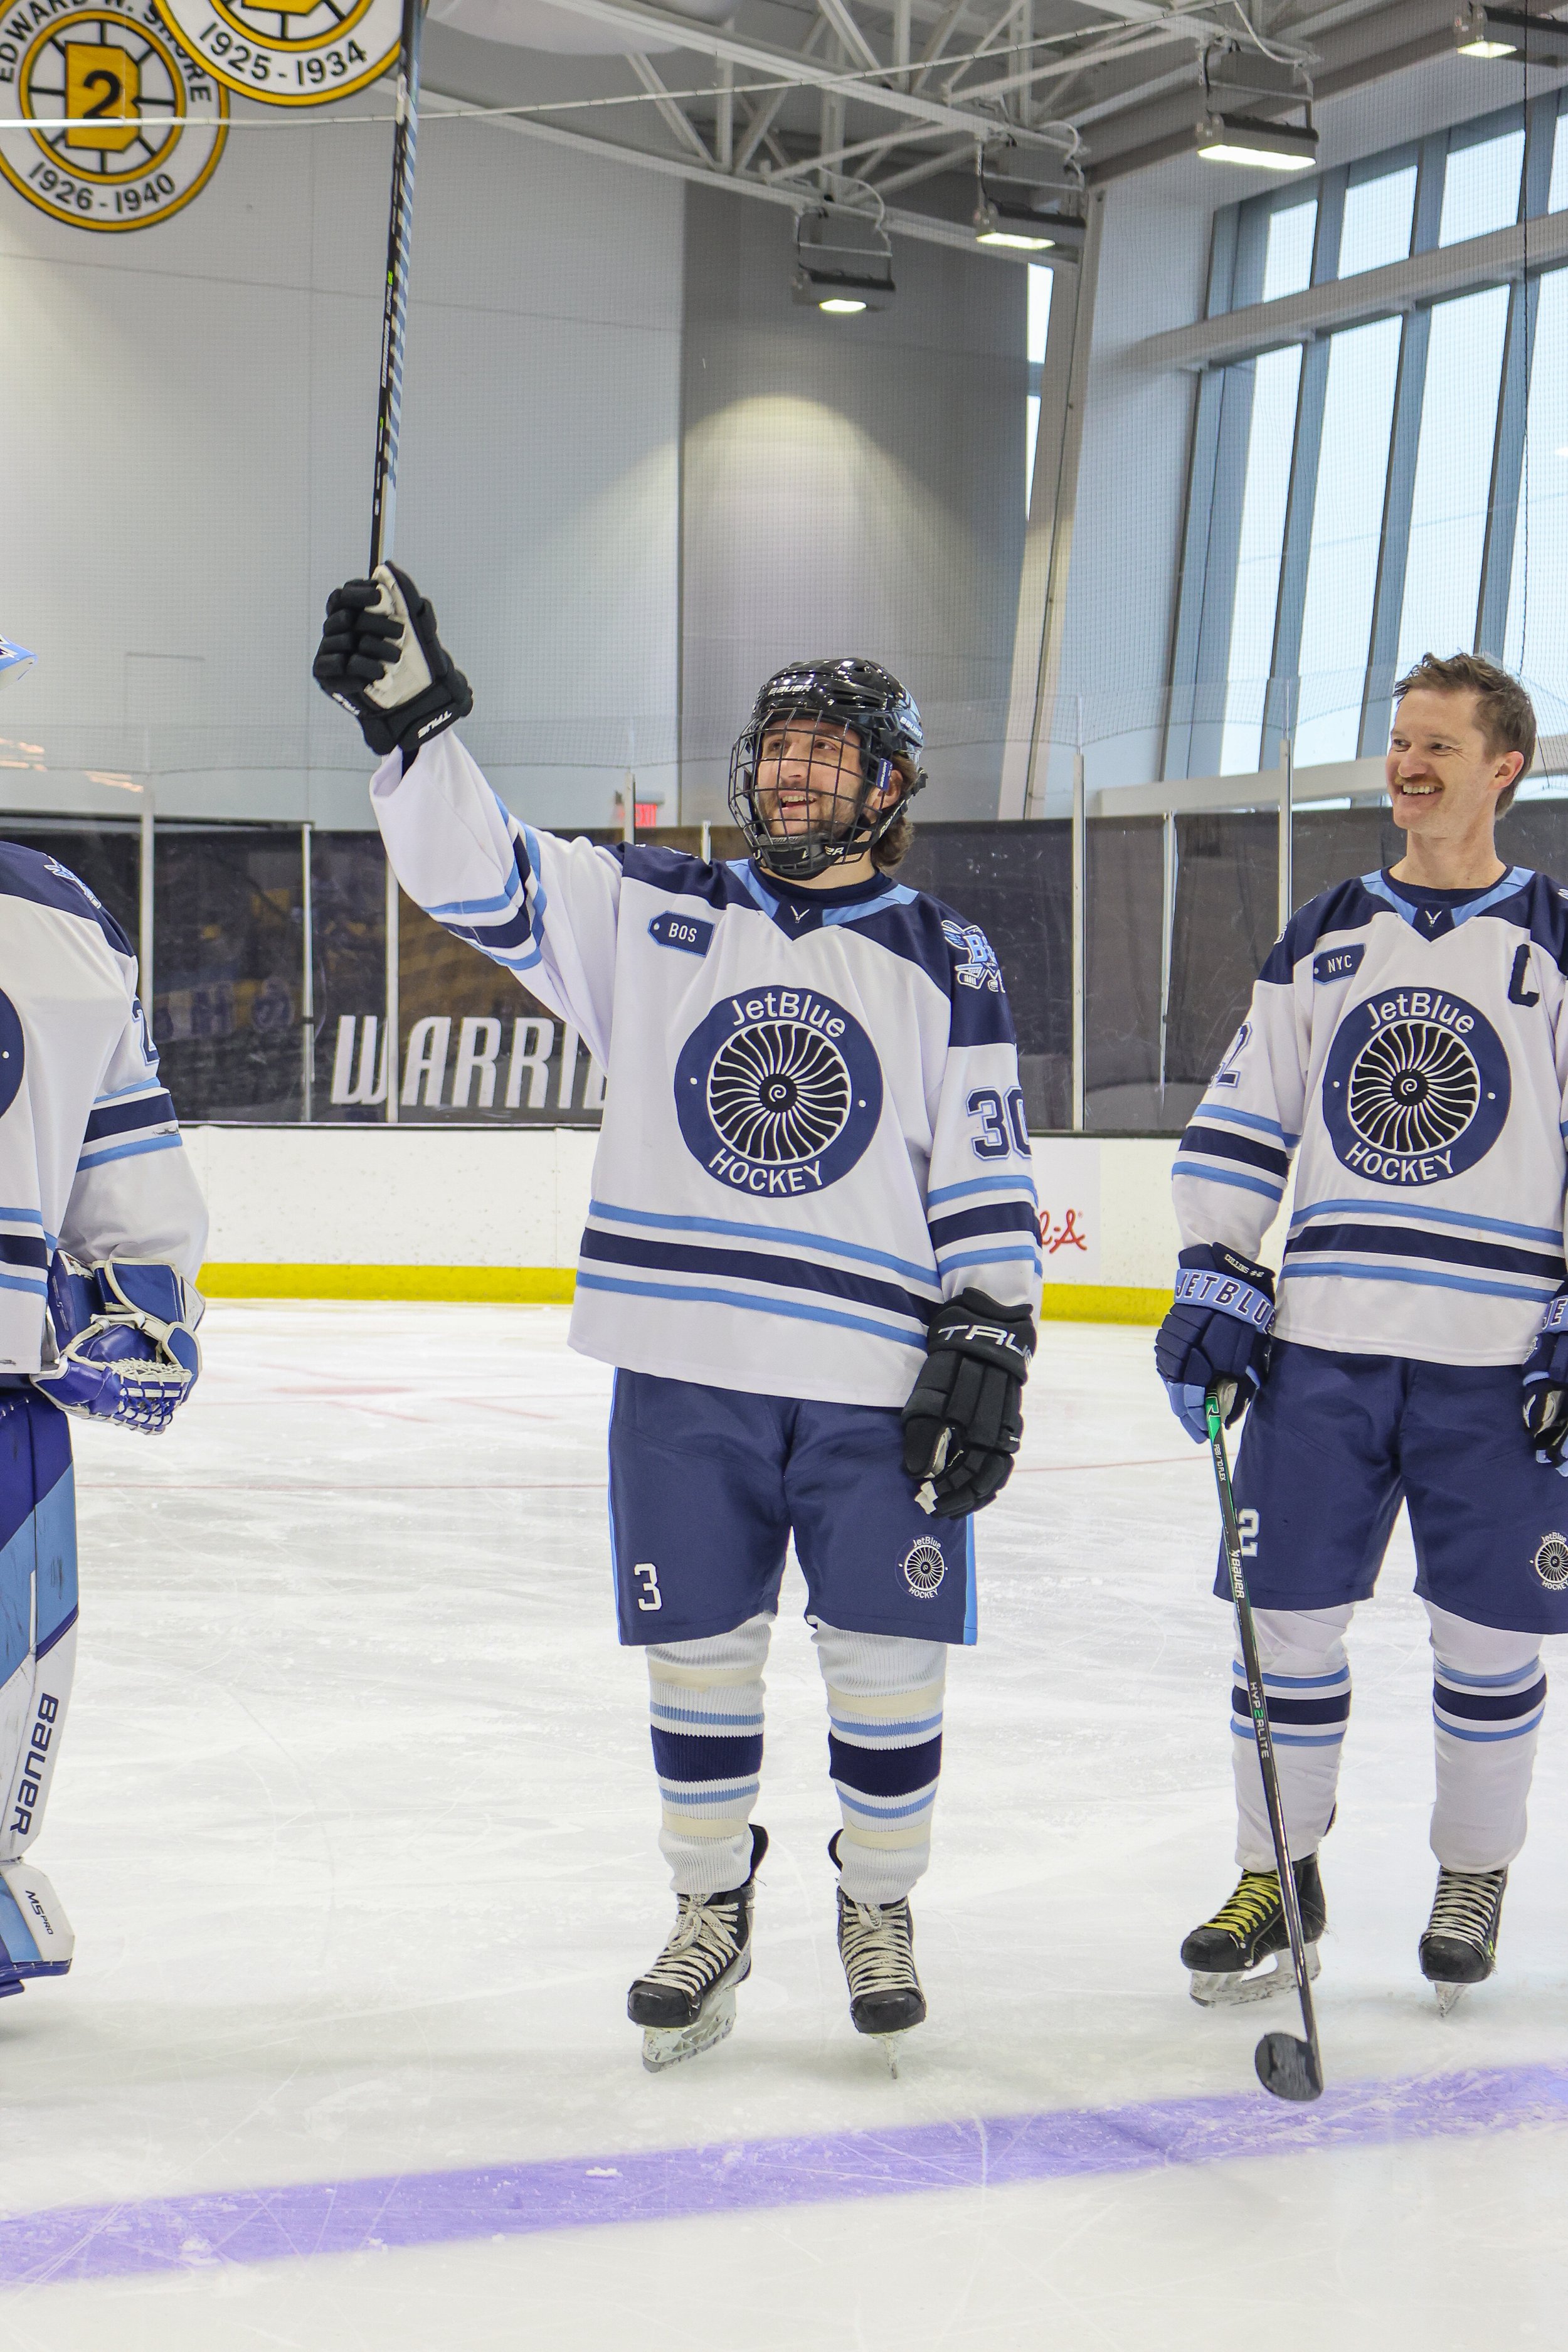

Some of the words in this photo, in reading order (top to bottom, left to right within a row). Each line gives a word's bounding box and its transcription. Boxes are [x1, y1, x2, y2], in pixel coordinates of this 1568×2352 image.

[0, 0, 88, 83] EDWAR
[82, 69, 123, 119] 2
[768, 684, 813, 696] BAUER
[899, 716, 923, 739] BAUER
[668, 922, 697, 943] BOS
[1327, 954, 1353, 973] NYC
[1508, 943, 1539, 1007] C
[732, 991, 846, 1037] JetBlue
[1367, 992, 1475, 1034] JetBlue
[709, 1148, 824, 1194] HOCKEY
[1345, 1142, 1453, 1183] HOCKEY
[913, 1536, 941, 1549] JetBlue
[1541, 1532, 1567, 1544] JetBlue
[634, 1563, 662, 1611] 3
[908, 1586, 939, 1599] HOCKEY
[1231, 1559, 1246, 1599] BAUER
[1542, 1579, 1568, 1590] HOCKEY
[10, 1693, 59, 1836] BAUER
